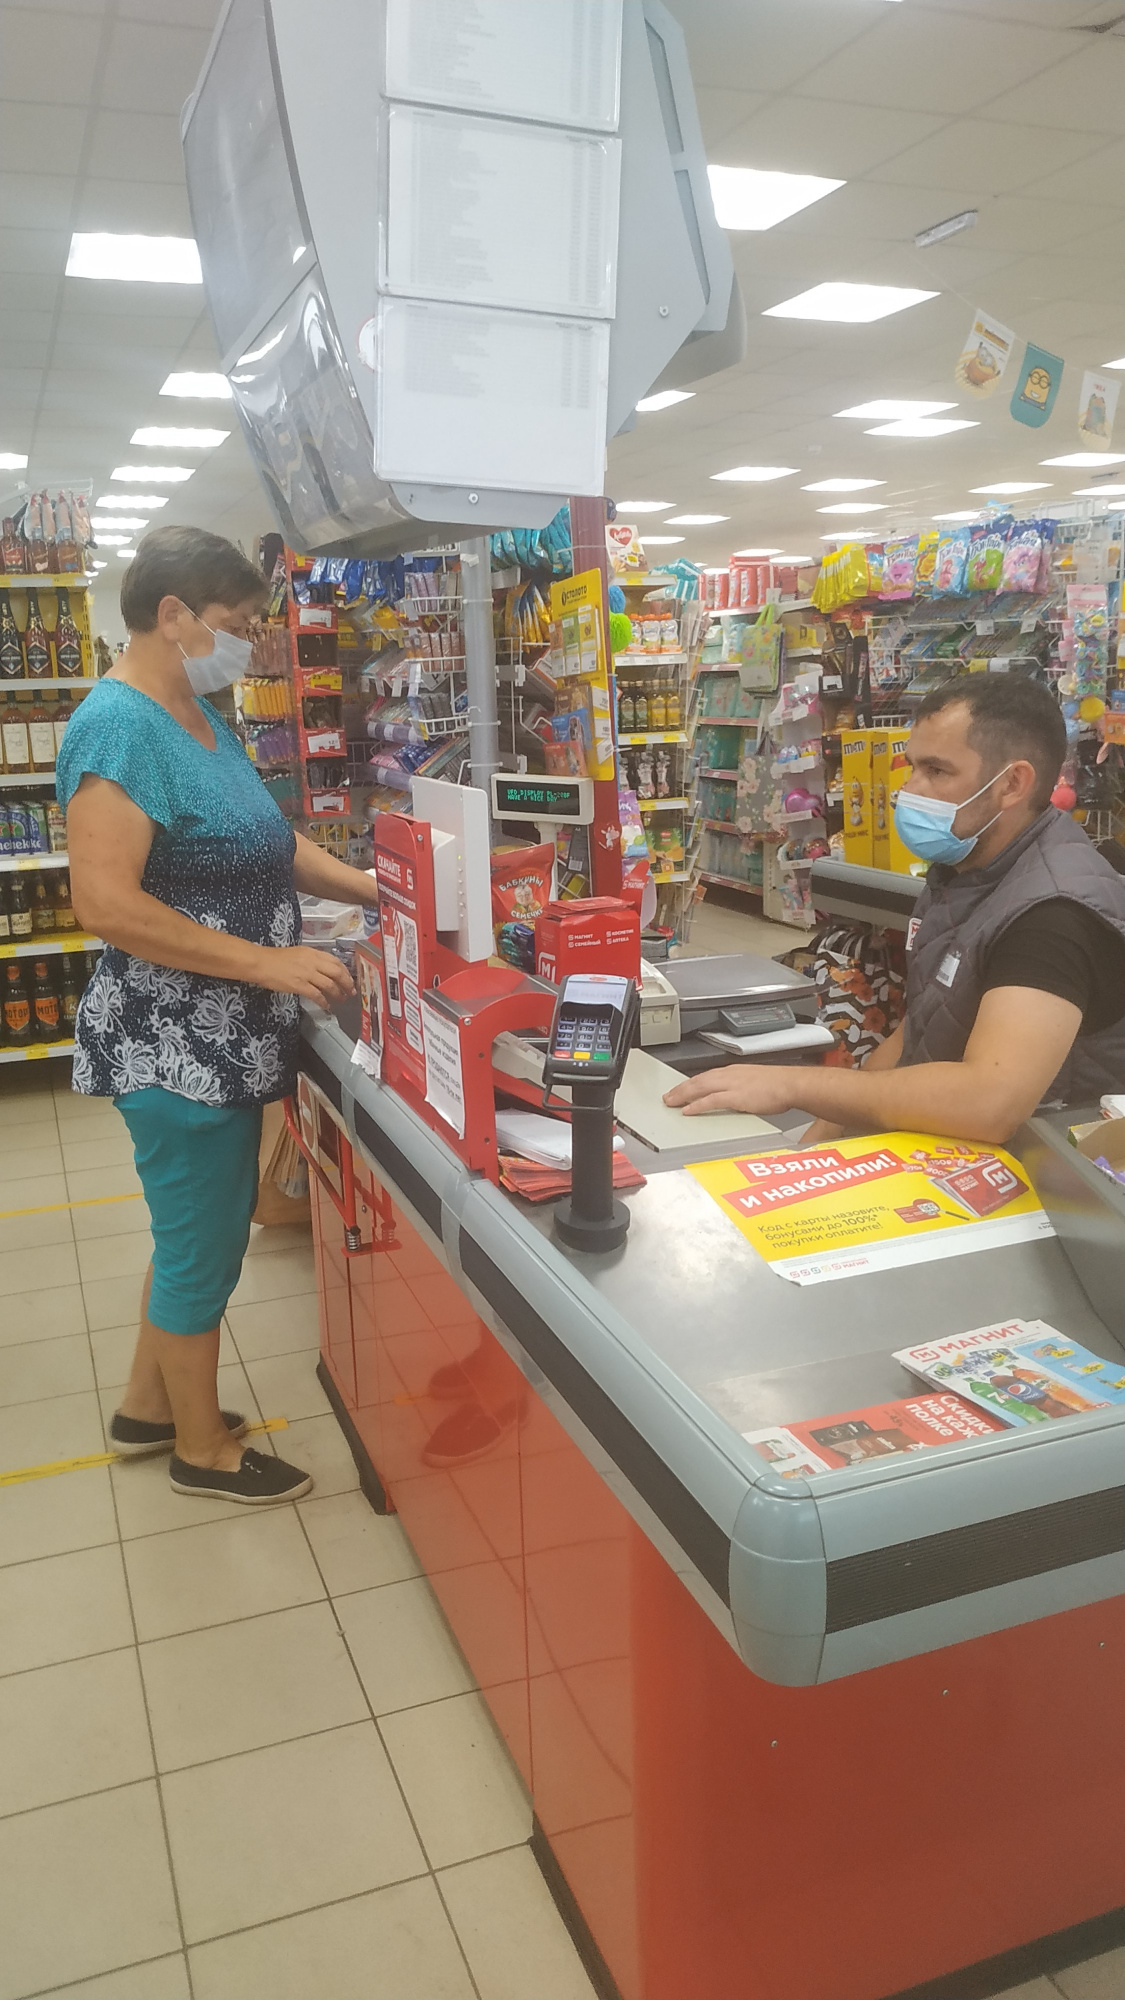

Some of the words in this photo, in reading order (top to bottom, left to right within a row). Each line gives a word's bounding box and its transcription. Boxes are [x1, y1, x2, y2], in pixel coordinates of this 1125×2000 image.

[377, 855, 401, 877] СКАЧАЙТЕ
[498, 875, 544, 892] БАБКИНЫ
[747, 1155, 839, 1177] Взяли
[739, 1195, 762, 1209] и
[762, 1154, 897, 1201] накопили!
[757, 1224, 783, 1234] Код
[795, 1215, 831, 1228] карты
[832, 1205, 890, 1220] назовите,
[765, 1224, 825, 1241] бонусами
[827, 1222, 843, 1232] до
[772, 1235, 823, 1249] покупки
[825, 1222, 883, 1239] оплатите!
[937, 1324, 1024, 1354] МАГНИТ
[922, 1399, 945, 1416] на
[906, 1404, 955, 1437] полке
